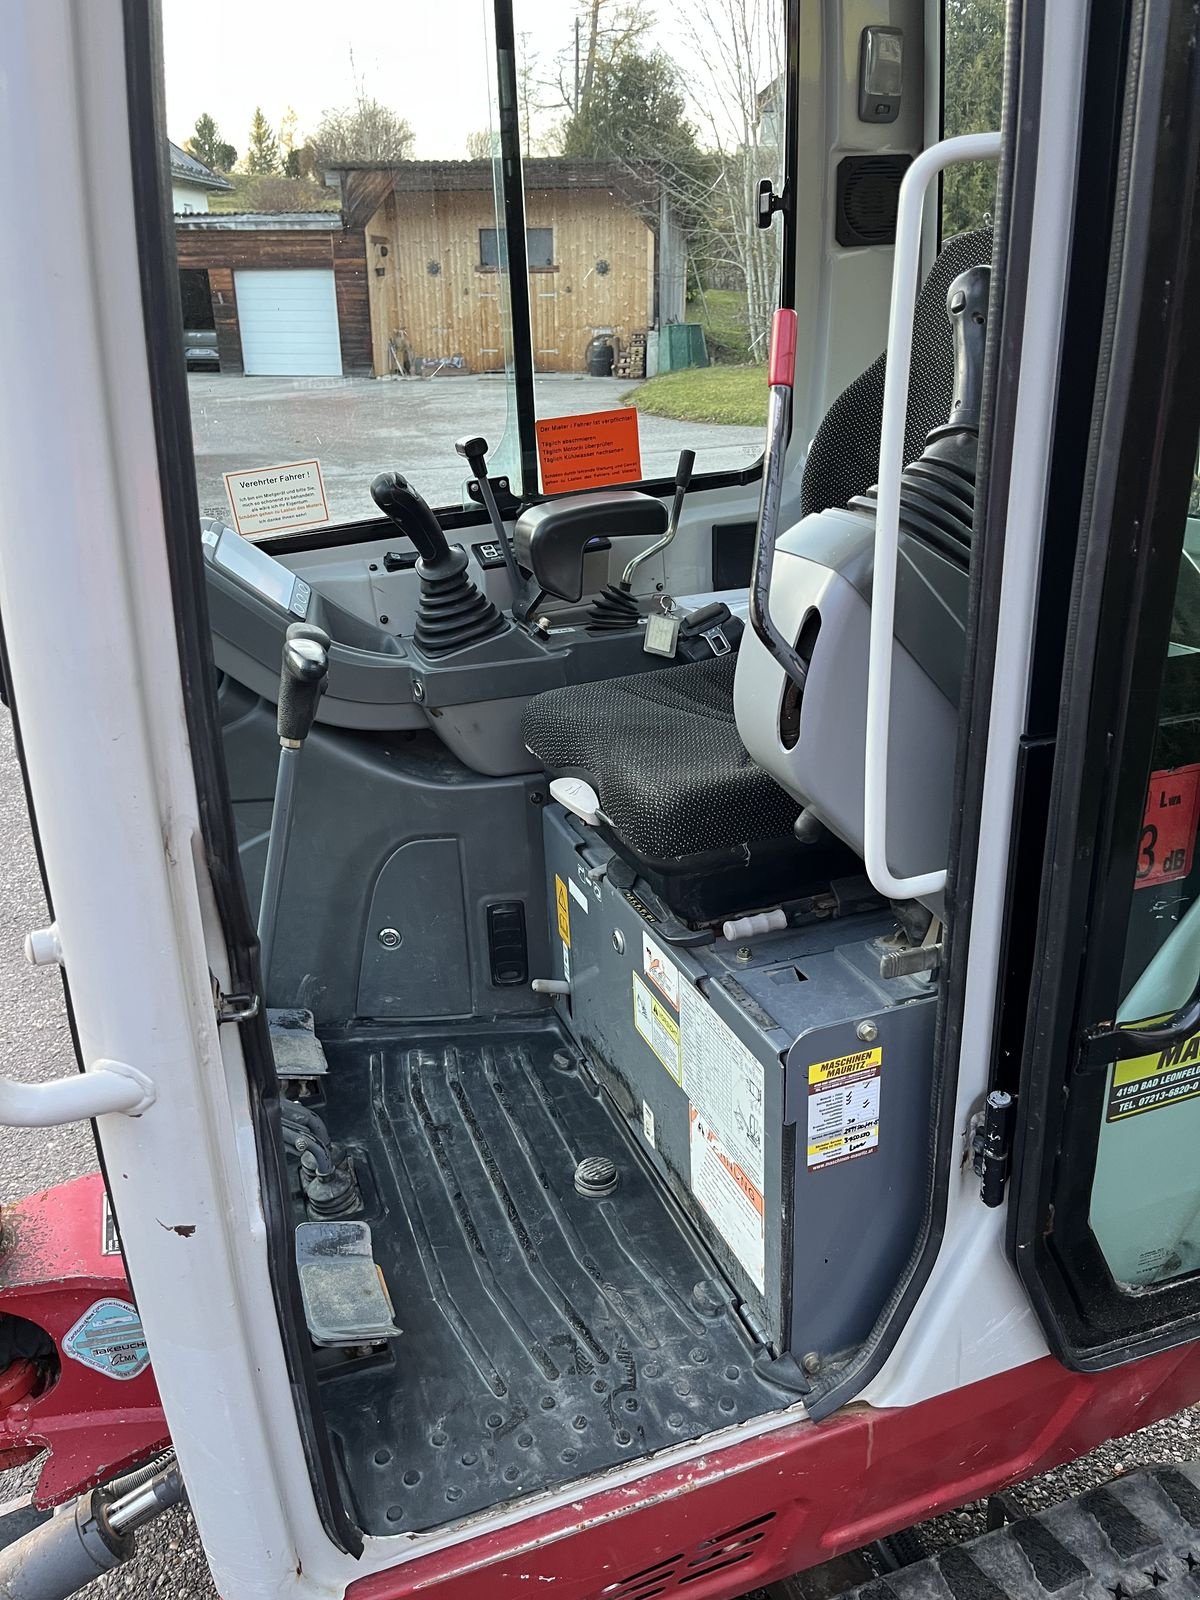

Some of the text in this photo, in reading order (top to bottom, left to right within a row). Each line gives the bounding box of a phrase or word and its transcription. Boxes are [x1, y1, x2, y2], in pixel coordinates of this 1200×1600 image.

[542, 439, 561, 448] Täglich
[240, 477, 277, 488] Verehrter
[280, 472, 305, 482] Fahrer
[1163, 848, 1186, 873] dB
[820, 1051, 872, 1072] MASCHINEN
[826, 1061, 866, 1078] MAURITZ
[1116, 1084, 1139, 1097] 4190
[1140, 1078, 1158, 1091] BAD
[1119, 1082, 1199, 1112] TEL. 07213-6820-0
